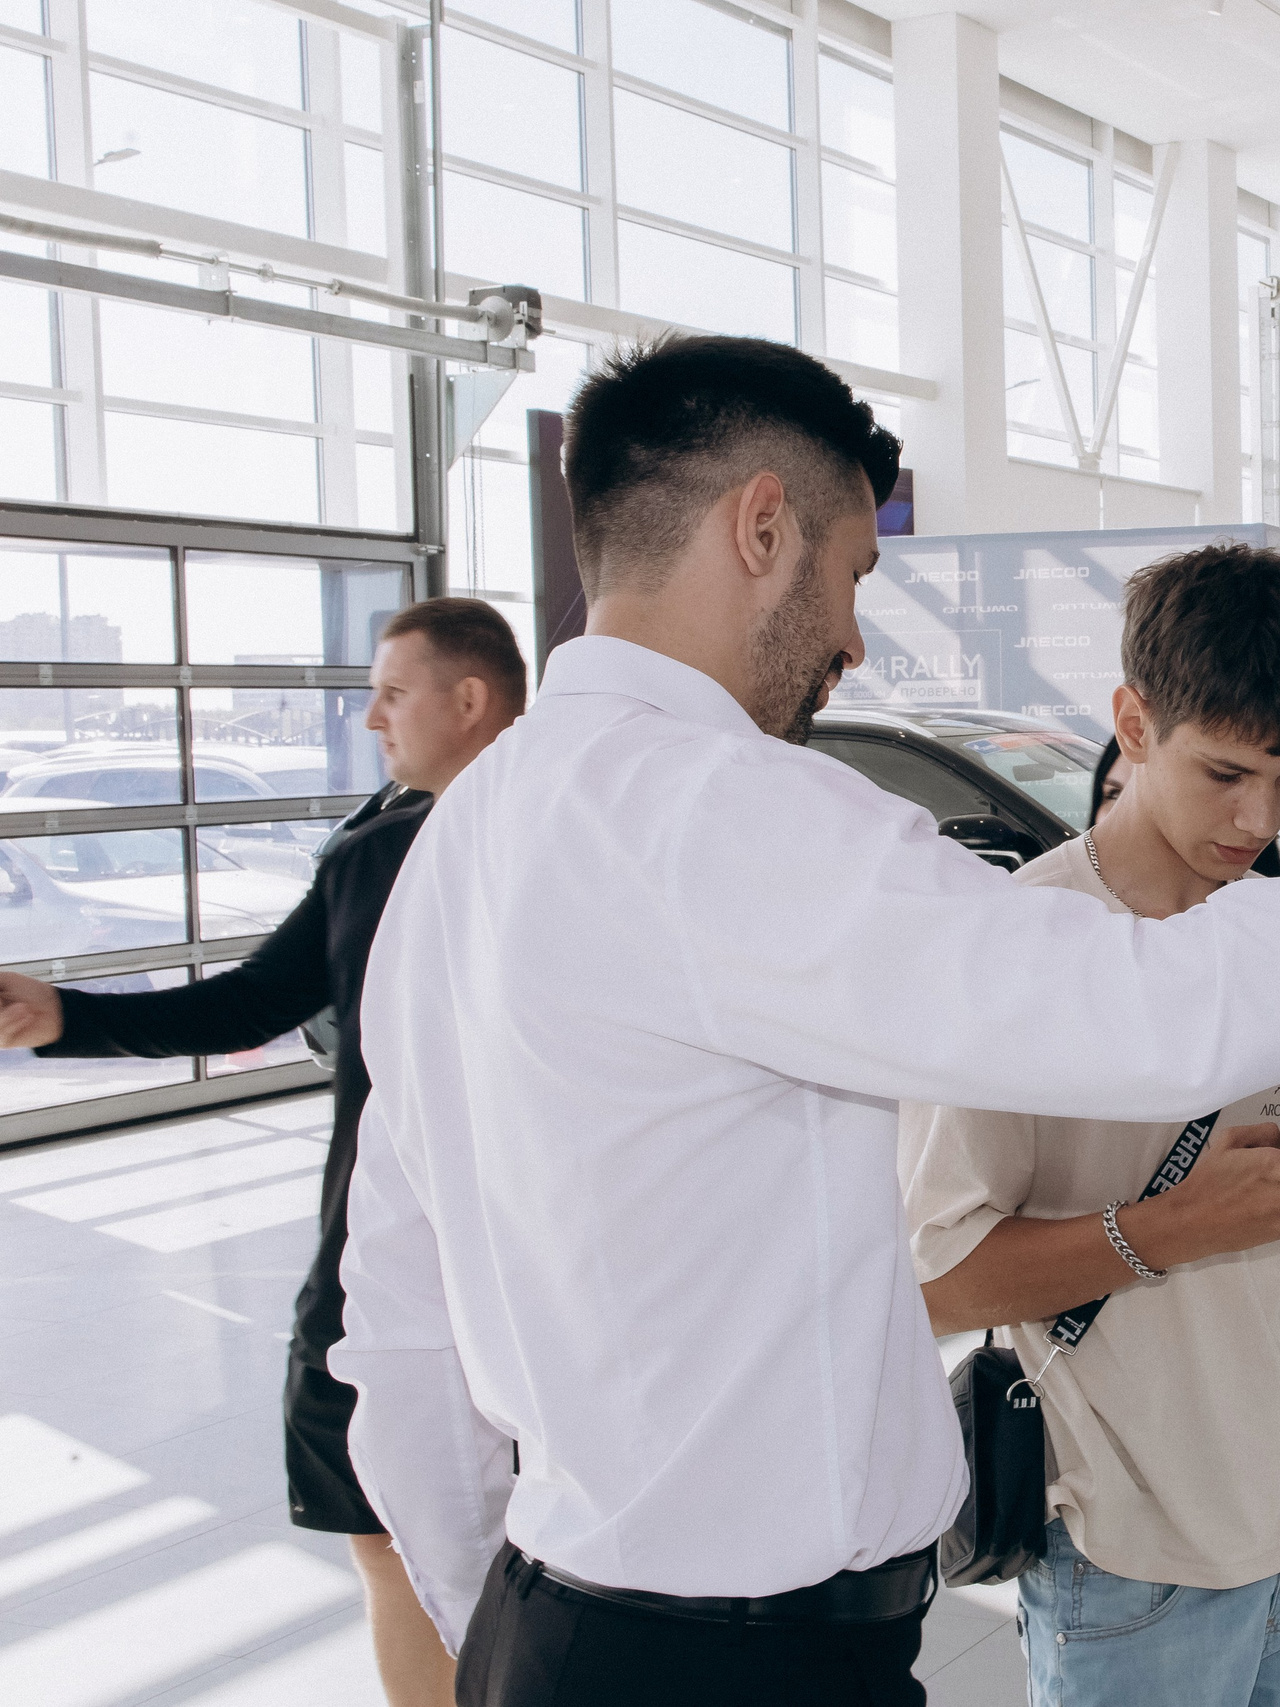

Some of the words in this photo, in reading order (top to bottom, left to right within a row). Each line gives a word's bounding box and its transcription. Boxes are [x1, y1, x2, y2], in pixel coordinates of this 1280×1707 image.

[905, 571, 979, 584] JAECOO
[1013, 566, 1090, 580] JAECOO
[1014, 636, 1090, 648] JAECOO
[890, 654, 980, 679] RALLY
[900, 686, 976, 697] ПРОВЕРЕНО
